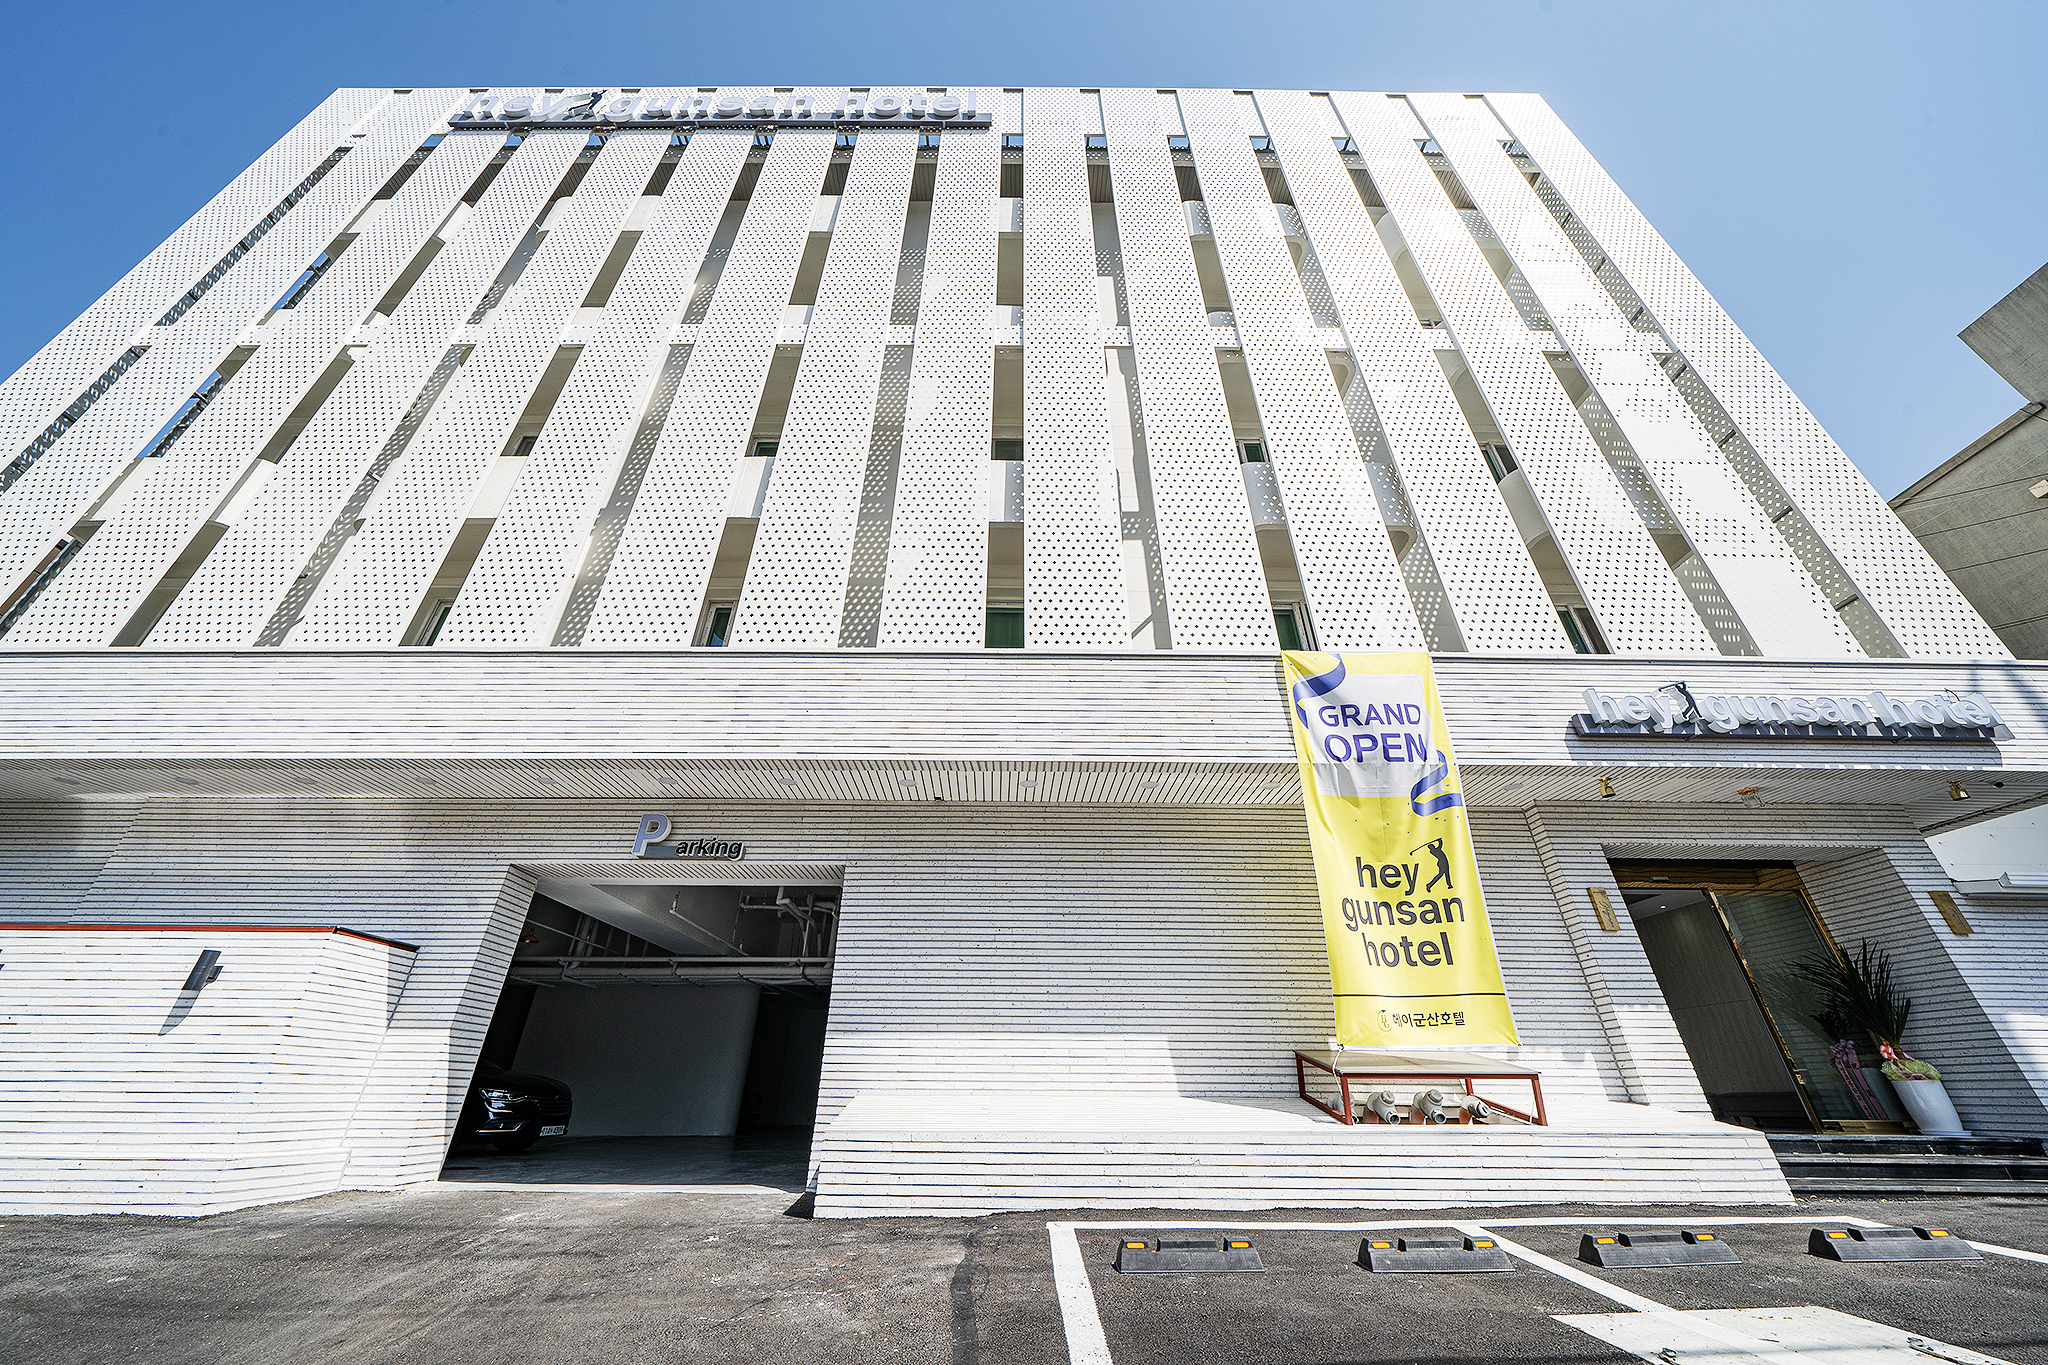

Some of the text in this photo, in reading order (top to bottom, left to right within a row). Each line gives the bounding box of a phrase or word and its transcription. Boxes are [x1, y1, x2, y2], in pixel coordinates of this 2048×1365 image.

[463, 90, 976, 122] hey gunsan hotel
[1318, 703, 1421, 727] GRAND
[1583, 688, 2005, 733] hey gunsan hotel
[1324, 733, 1427, 763] OPEN
[1355, 856, 1419, 896] hey
[1341, 897, 1465, 932] gunsan
[1361, 931, 1454, 967] hotel
[1392, 1011, 1465, 1028] 헤이군산호텔
